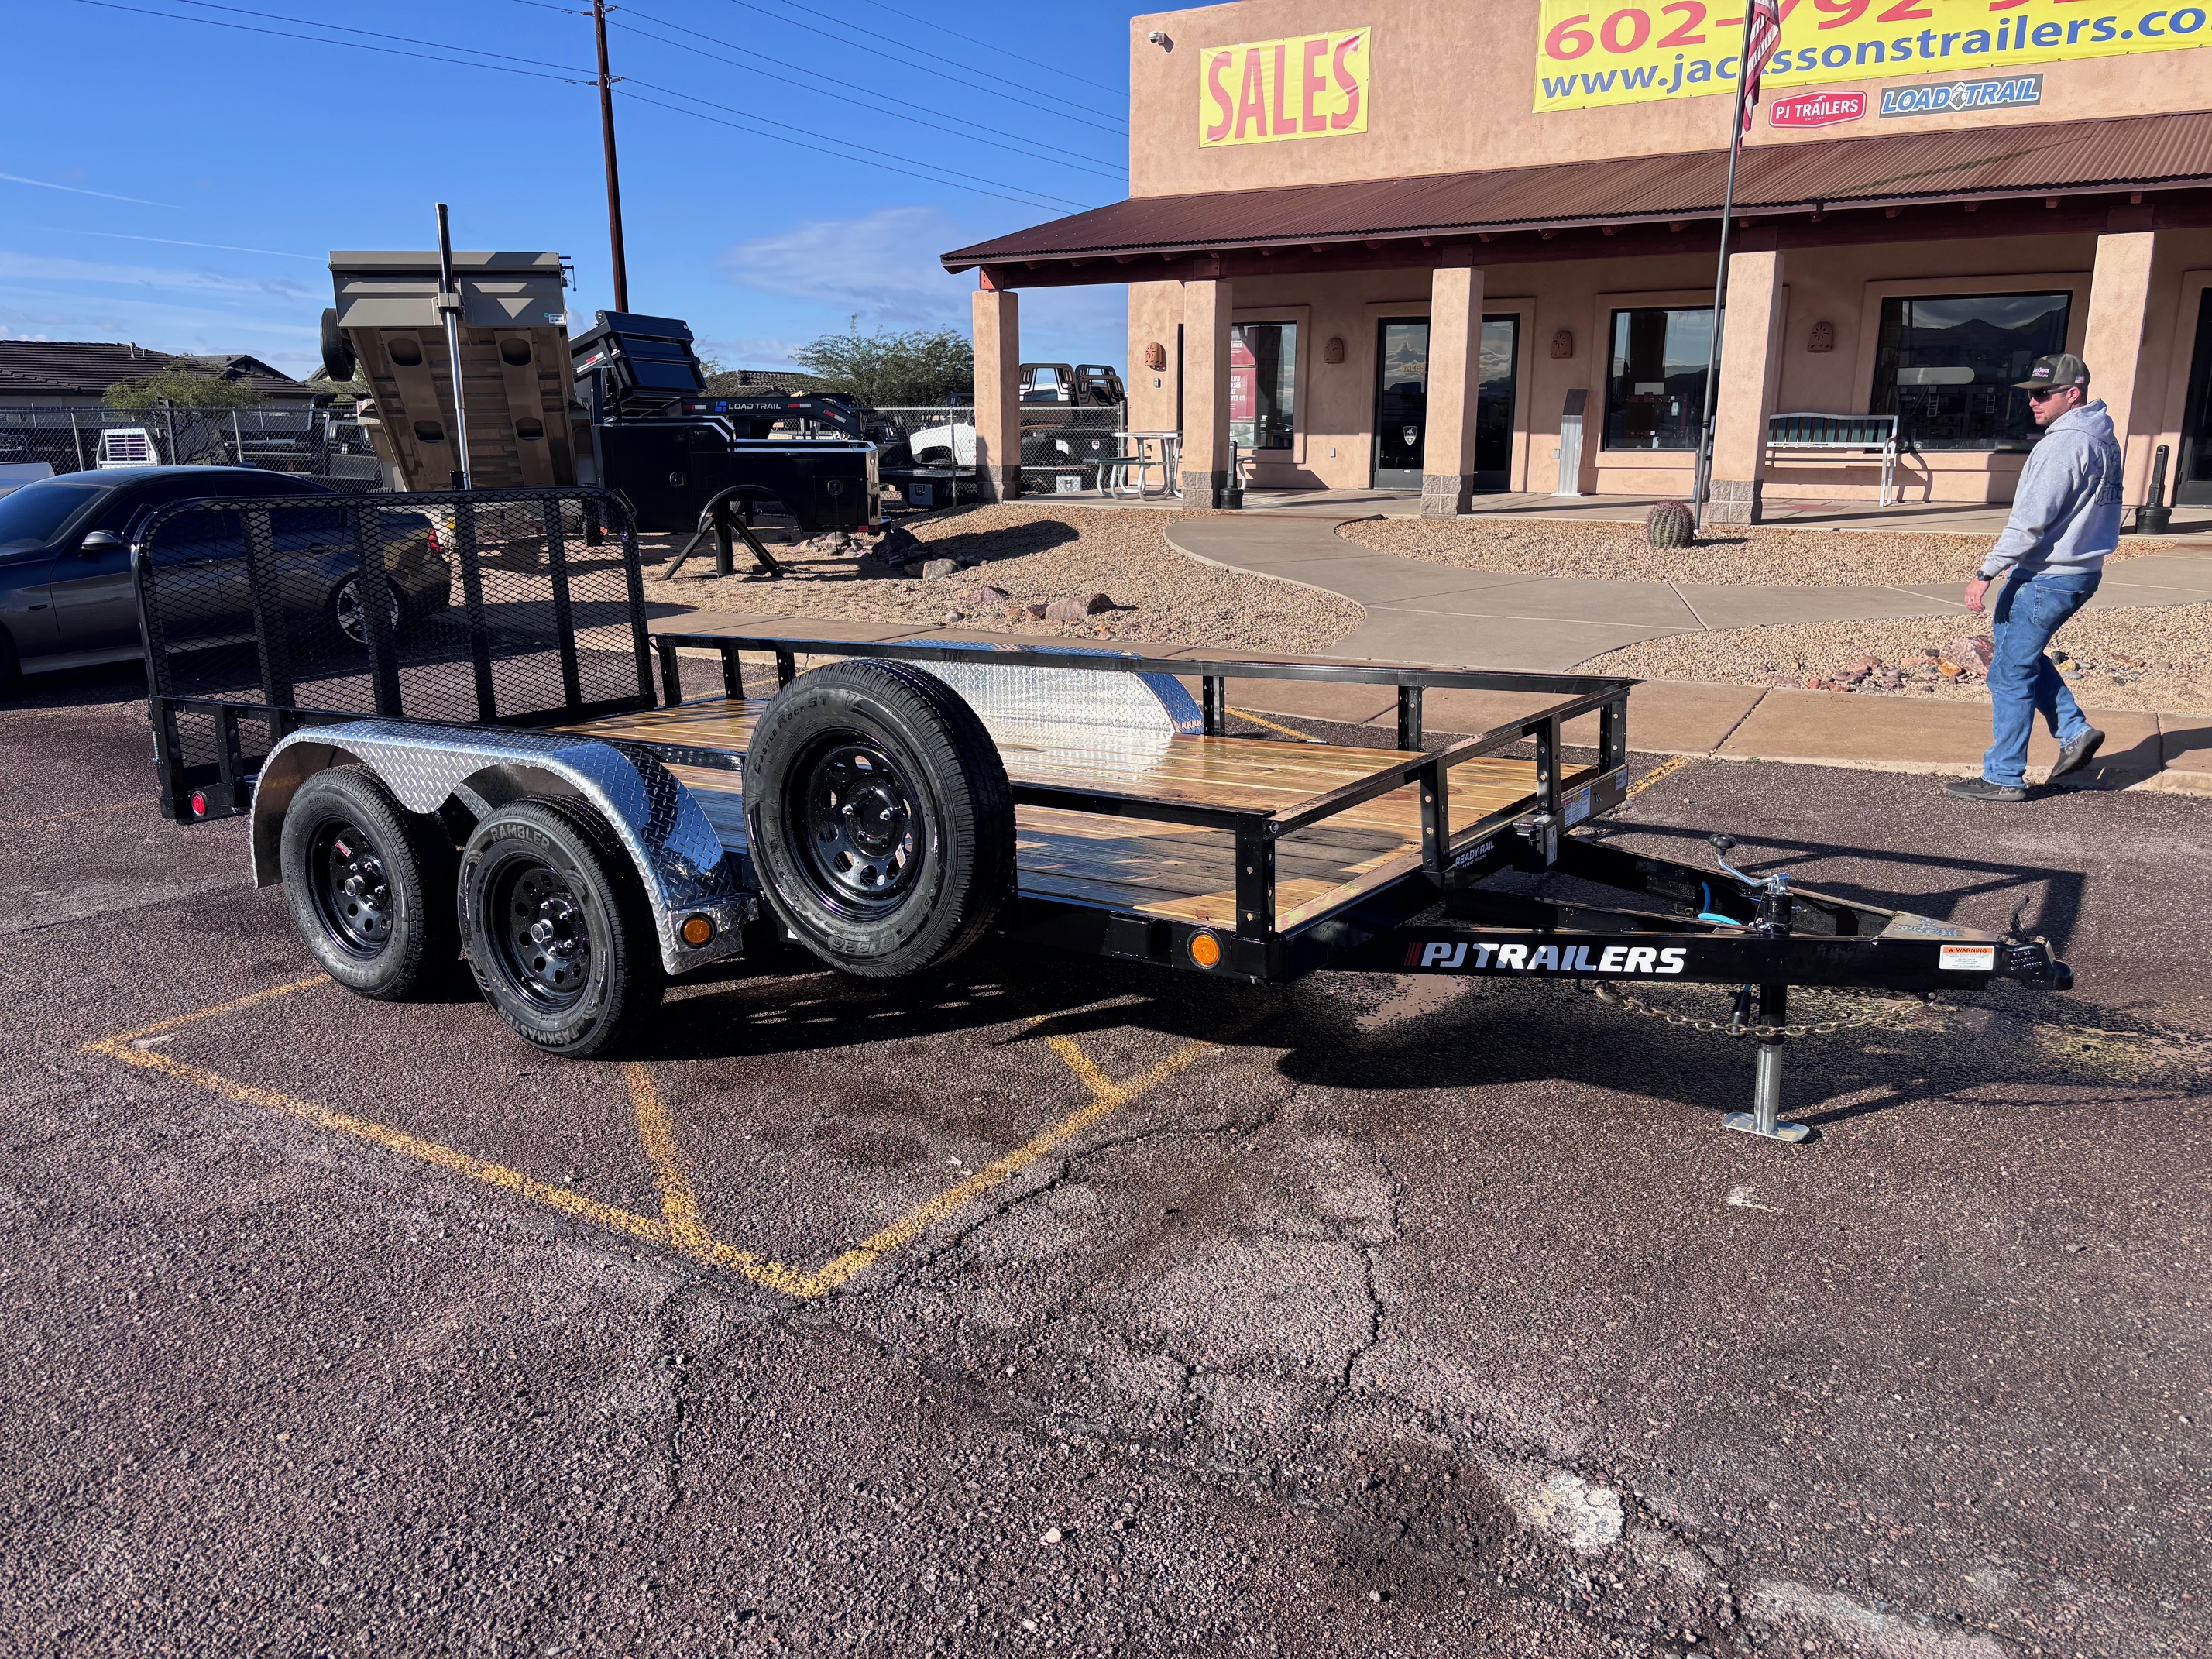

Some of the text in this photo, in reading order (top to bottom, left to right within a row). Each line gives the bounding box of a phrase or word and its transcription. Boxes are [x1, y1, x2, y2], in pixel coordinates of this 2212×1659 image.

[1541, 7, 2212, 98] www.jacsonstrailers.co
[1207, 36, 1360, 142] SALES
[1882, 78, 2039, 113] LOAD TRAIL
[1775, 99, 1859, 119] PJ TRAILERS
[490, 824, 551, 852] RAMBLER
[1420, 943, 1687, 974] PJ TRAILERS
[497, 1004, 580, 1045] TASKMASTER
